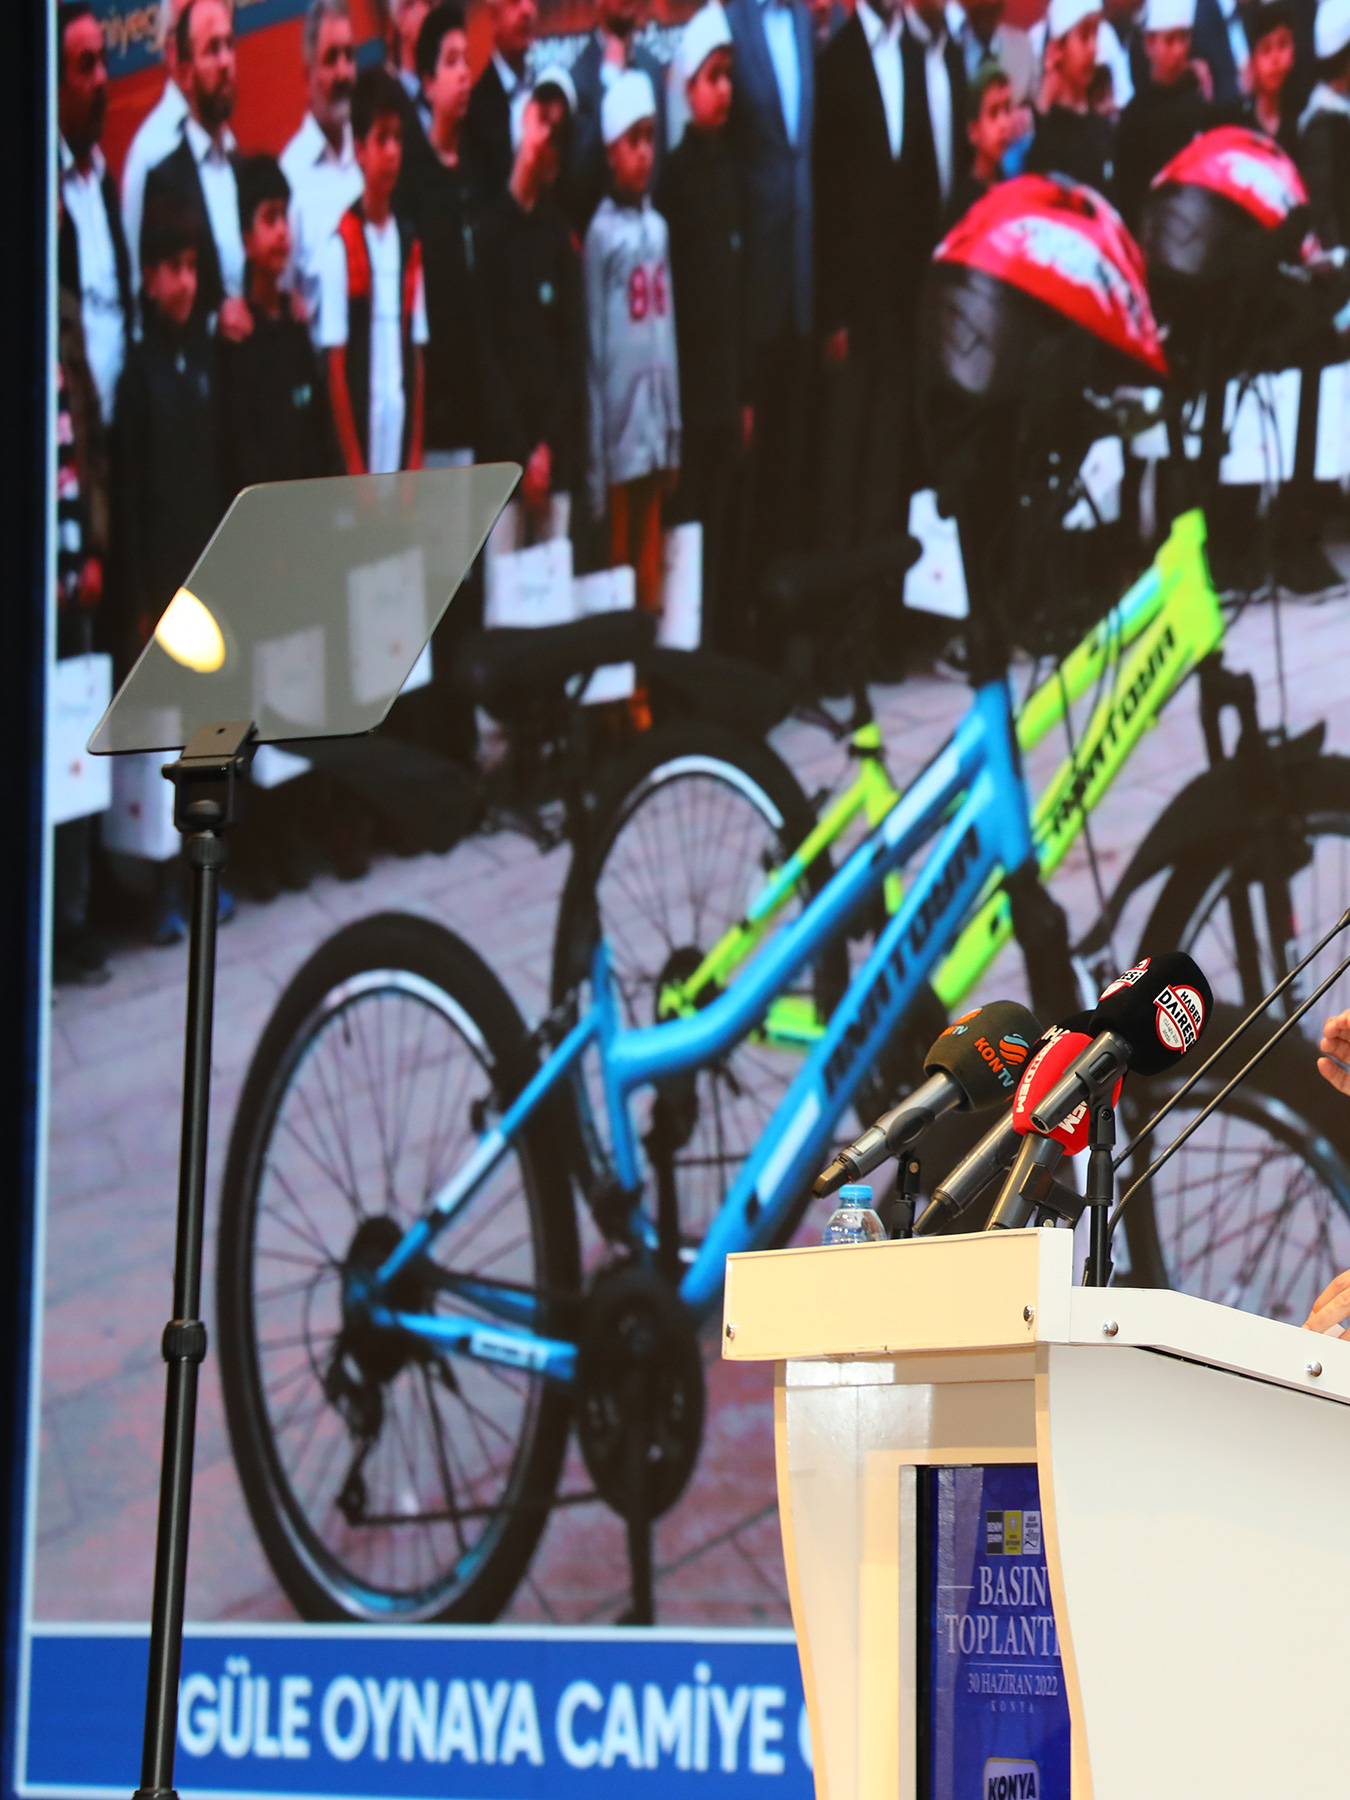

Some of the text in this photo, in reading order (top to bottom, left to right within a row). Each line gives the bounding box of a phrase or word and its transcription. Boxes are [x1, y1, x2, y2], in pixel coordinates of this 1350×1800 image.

[1180, 991, 1201, 1025] HABER
[979, 1566, 1048, 1606] BASIN
[967, 1669, 1059, 1696] 30 HAZİRAN 2022
[177, 1655, 313, 1759] GÜLE
[320, 1674, 545, 1765] OYNAYA
[555, 1659, 787, 1775] CAMİYE
[990, 1700, 1035, 1713] KONYA
[988, 1772, 1037, 1800] KONYA
